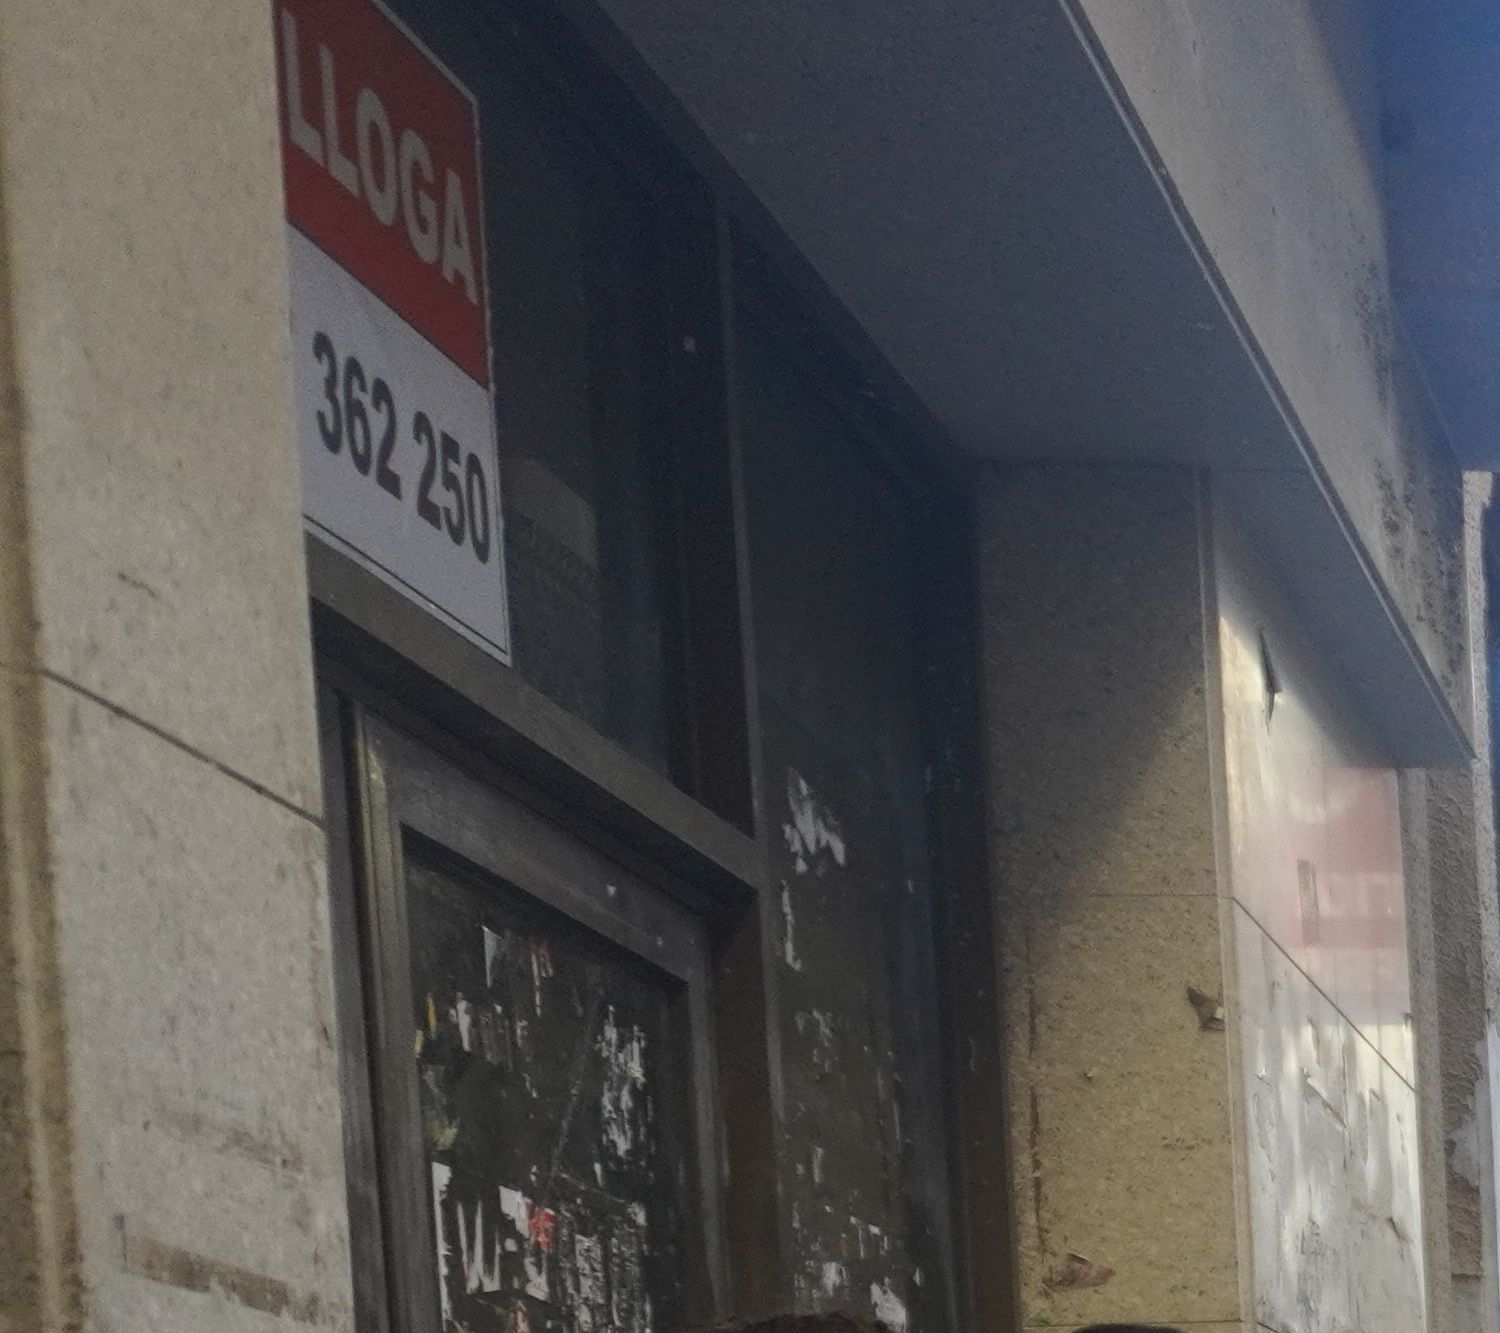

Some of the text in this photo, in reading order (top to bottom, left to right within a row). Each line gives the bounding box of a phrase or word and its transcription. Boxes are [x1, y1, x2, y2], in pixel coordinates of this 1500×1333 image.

[282, 8, 478, 306] LLOGA
[312, 330, 490, 565] 362 250
